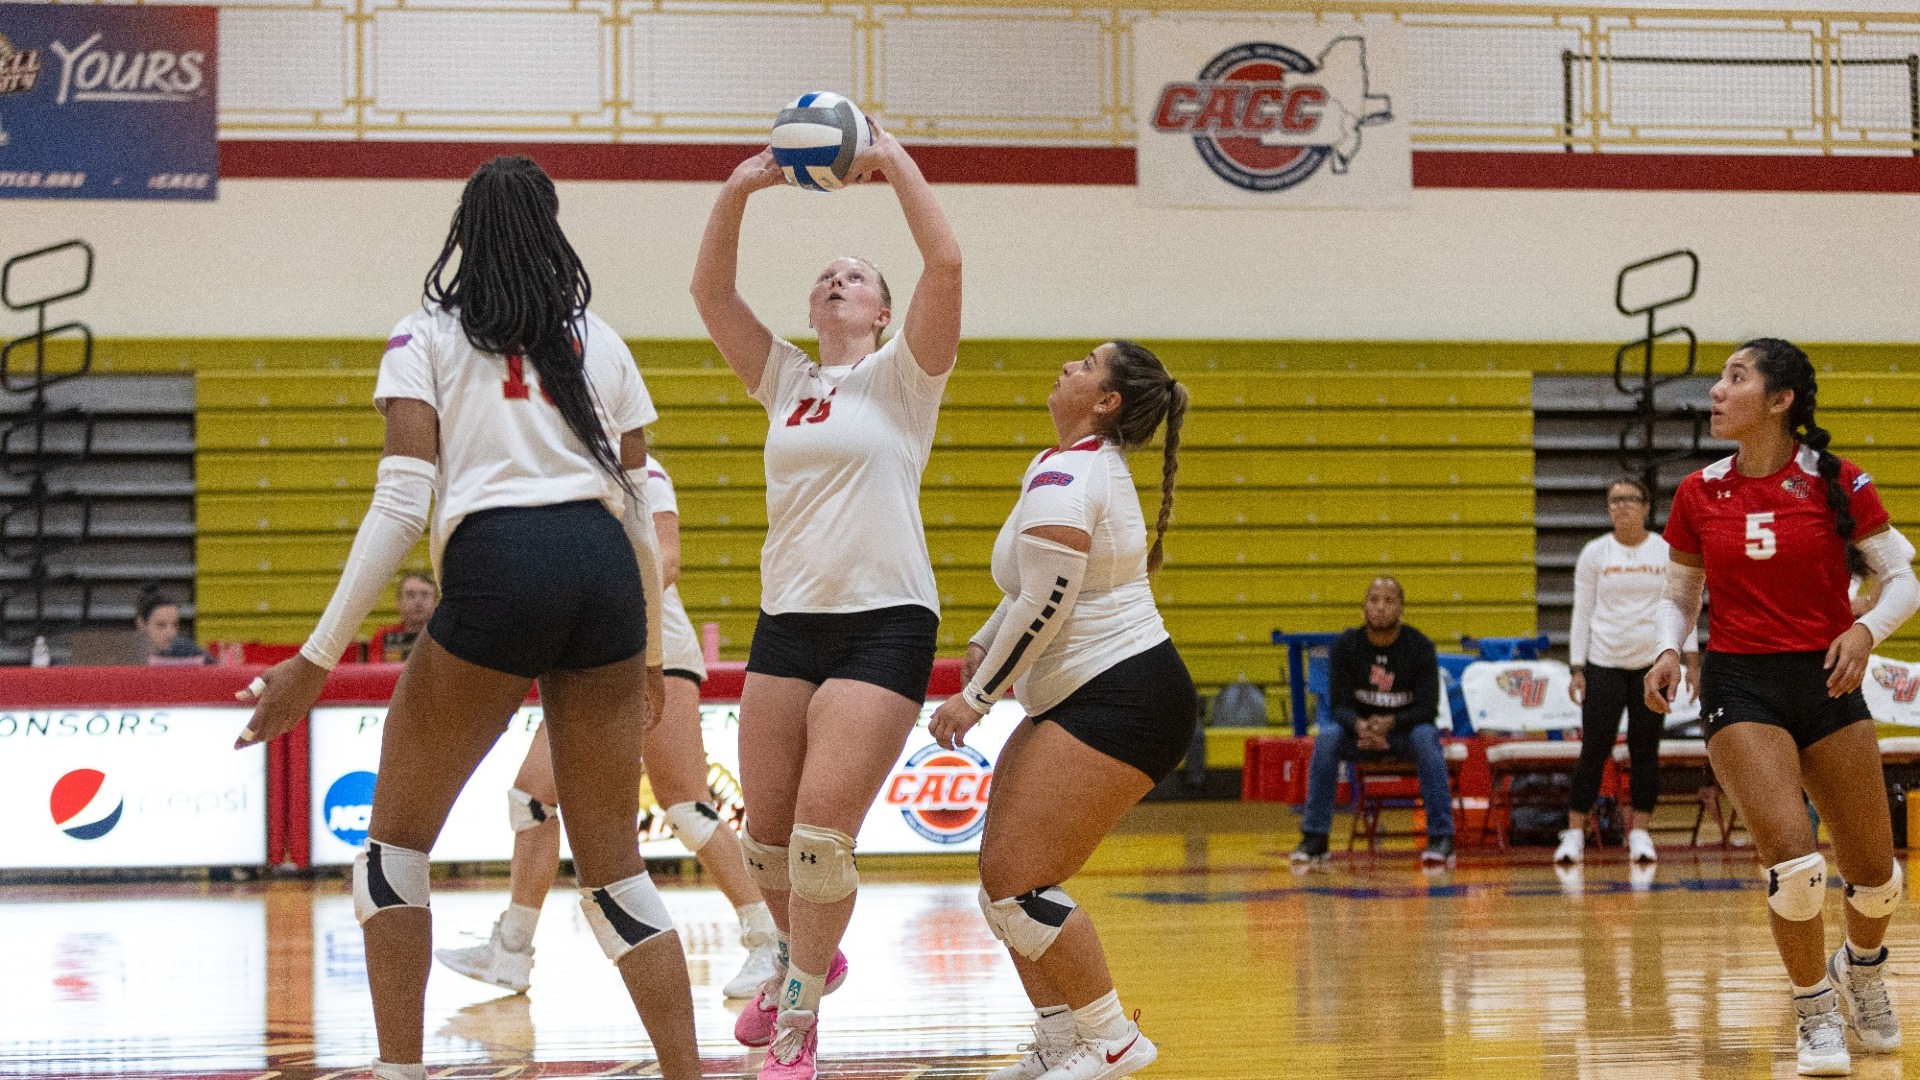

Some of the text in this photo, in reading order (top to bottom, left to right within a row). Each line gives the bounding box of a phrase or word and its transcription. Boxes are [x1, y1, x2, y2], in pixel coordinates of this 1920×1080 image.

[1152, 82, 1328, 133] CACC
[1745, 512, 1777, 560] 5
[138, 782, 248, 820] pepsi
